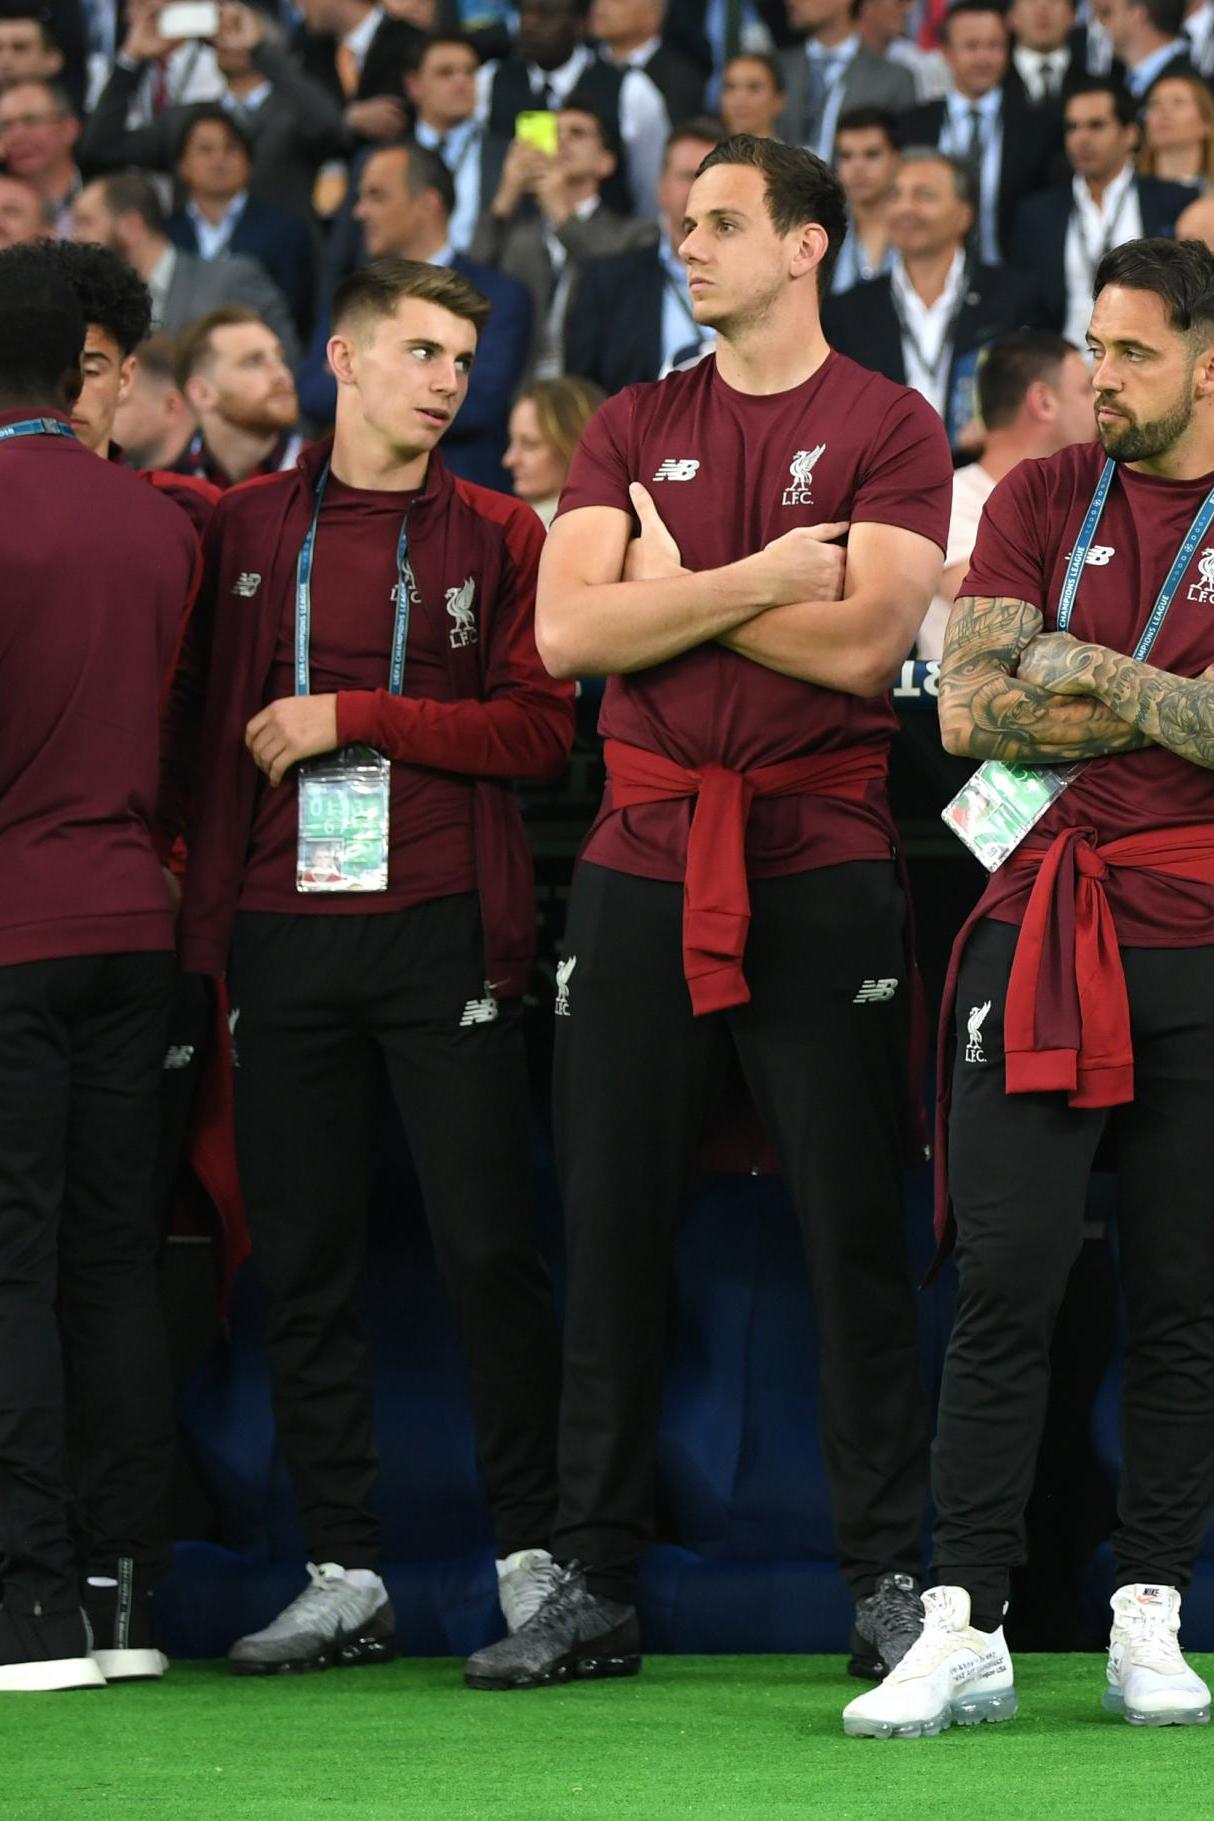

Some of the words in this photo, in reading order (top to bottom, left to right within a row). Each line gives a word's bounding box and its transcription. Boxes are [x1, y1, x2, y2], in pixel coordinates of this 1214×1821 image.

[1059, 578, 1075, 628] CHAMPIONS
[1070, 546, 1085, 578] LEAGUE
[1152, 594, 1170, 626] LEAGUE
